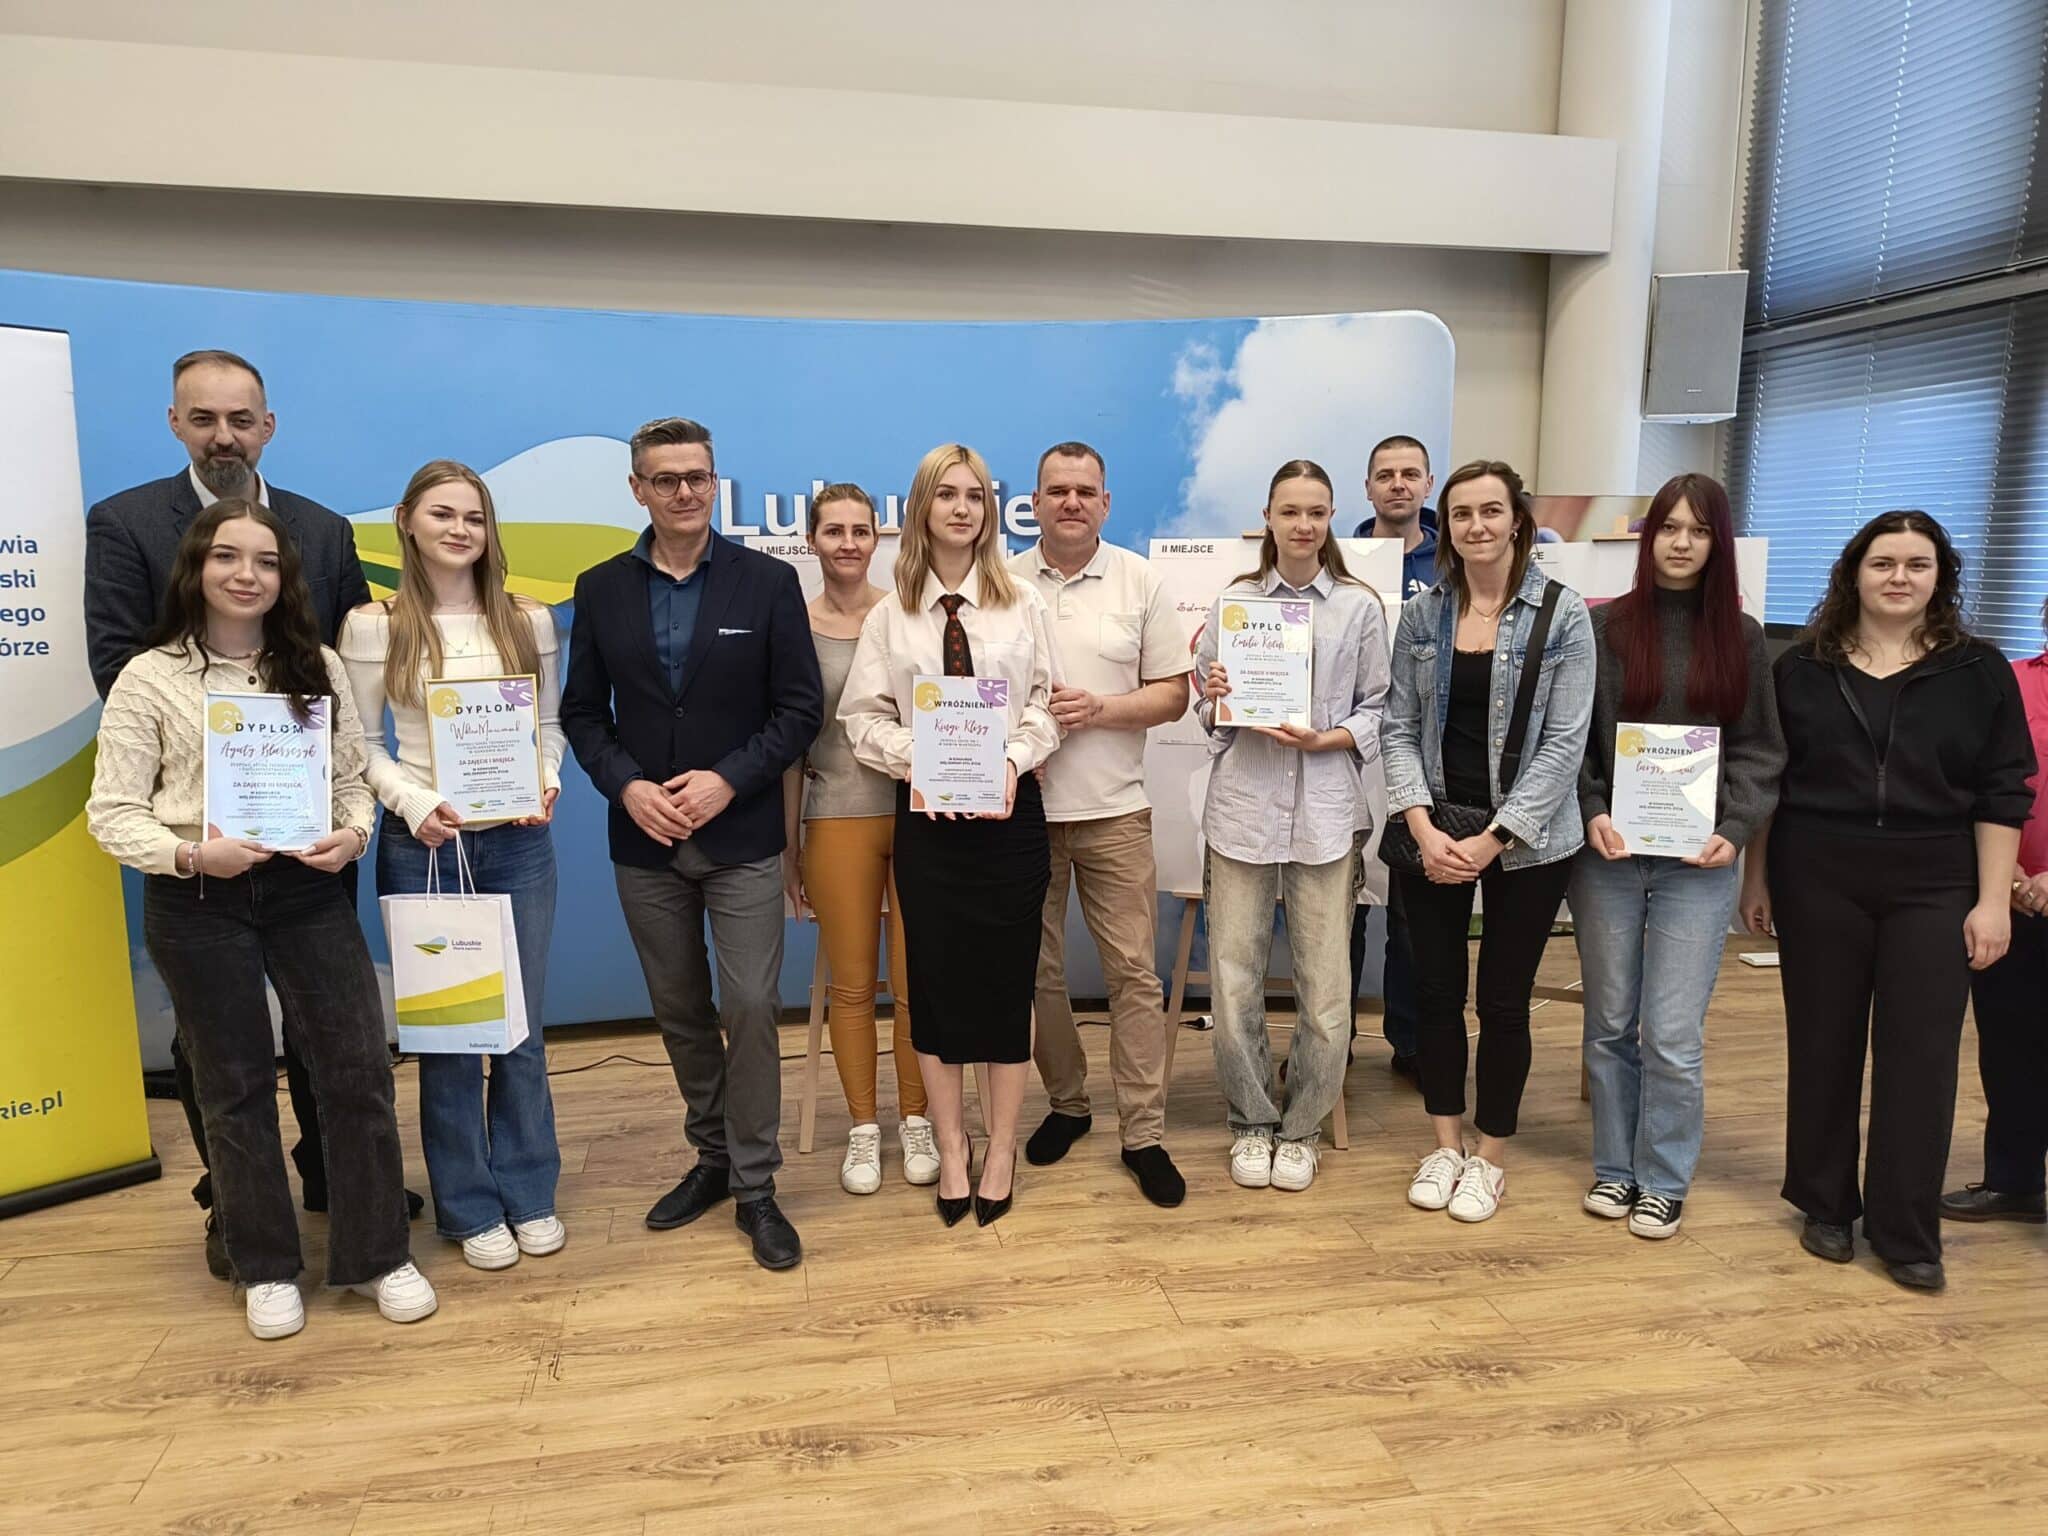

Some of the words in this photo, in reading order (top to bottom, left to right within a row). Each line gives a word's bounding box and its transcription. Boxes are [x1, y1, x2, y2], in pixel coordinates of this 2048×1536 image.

[1170, 544, 1214, 553] MIEJSCE
[456, 703, 516, 715] DYPLOM
[235, 722, 304, 734] DYPLOM
